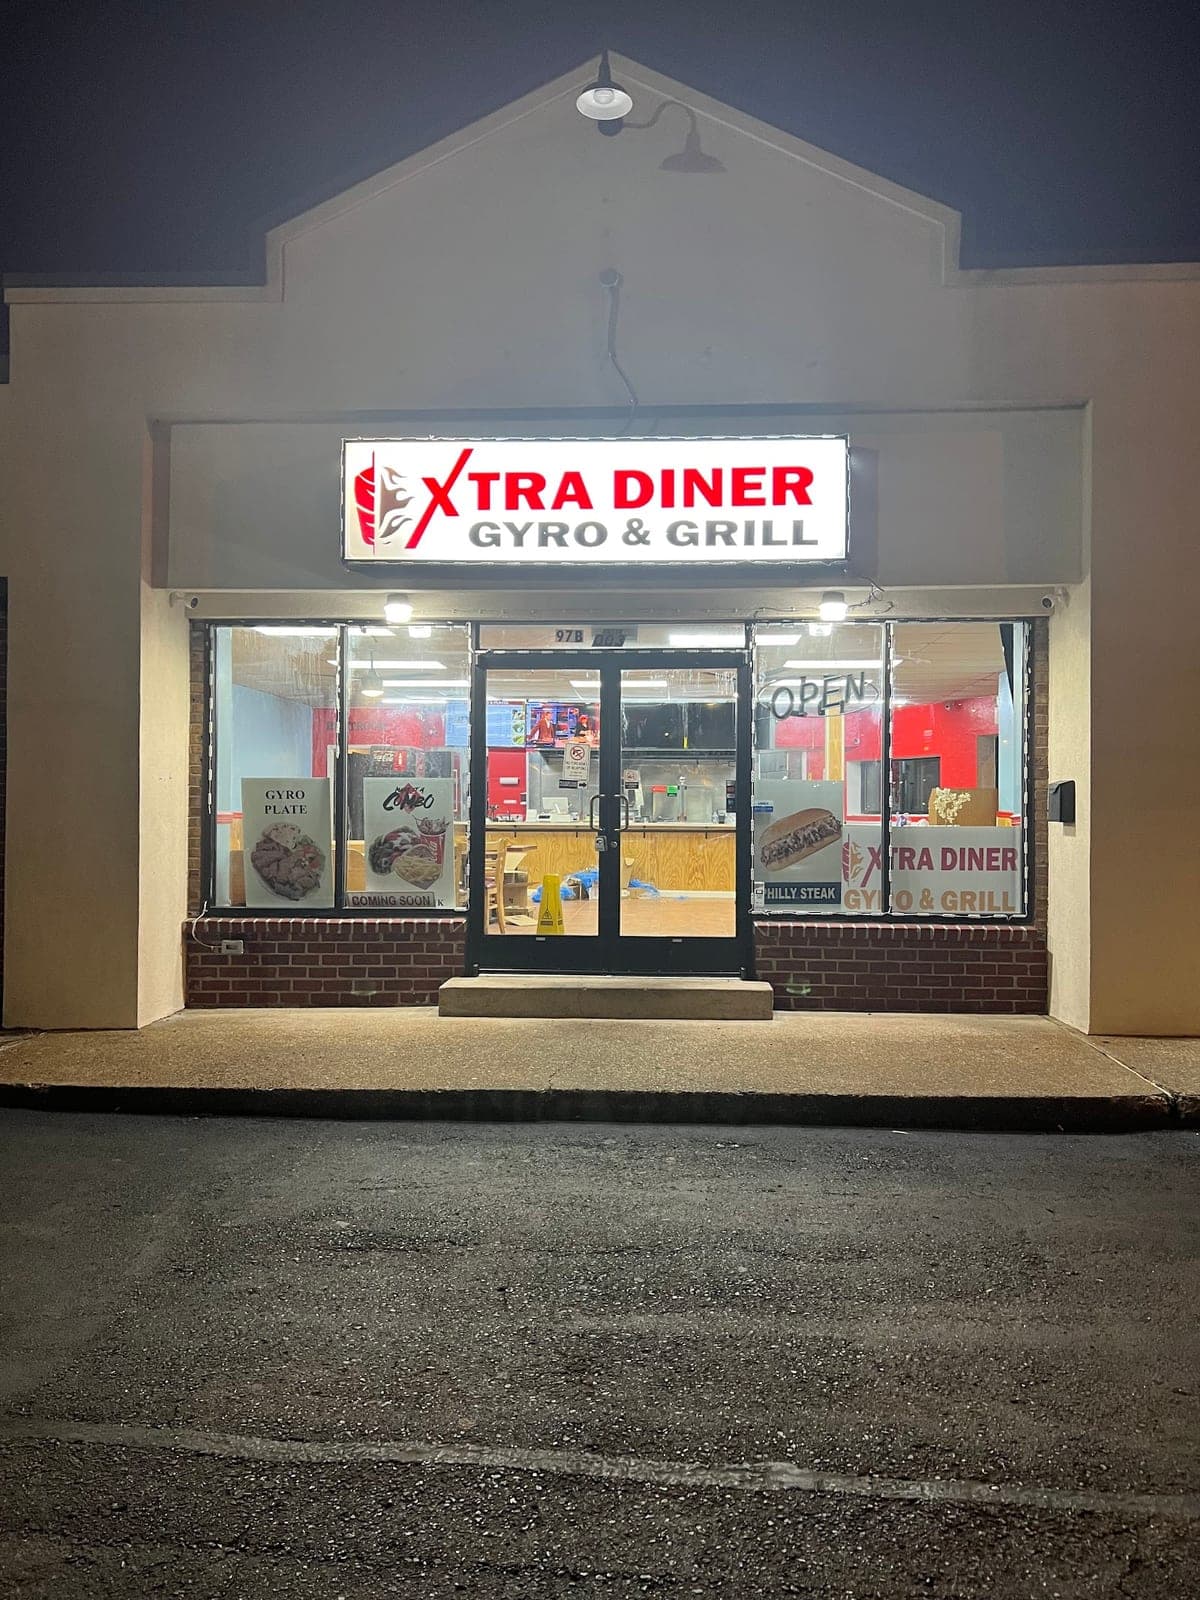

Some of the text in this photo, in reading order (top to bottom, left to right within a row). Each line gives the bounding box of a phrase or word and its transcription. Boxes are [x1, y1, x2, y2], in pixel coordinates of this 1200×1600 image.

[405, 448, 814, 549] XTRA DINER
[469, 518, 819, 548] GYRO & GRILL
[772, 672, 864, 719] OPEN
[265, 790, 305, 800] GYRO
[264, 804, 308, 815] PLATE
[941, 847, 1018, 871] DINER
[351, 895, 430, 906] COMING SOON
[801, 887, 836, 899] STEAK
[919, 888, 934, 910] &
[941, 889, 1016, 912] GRILL
